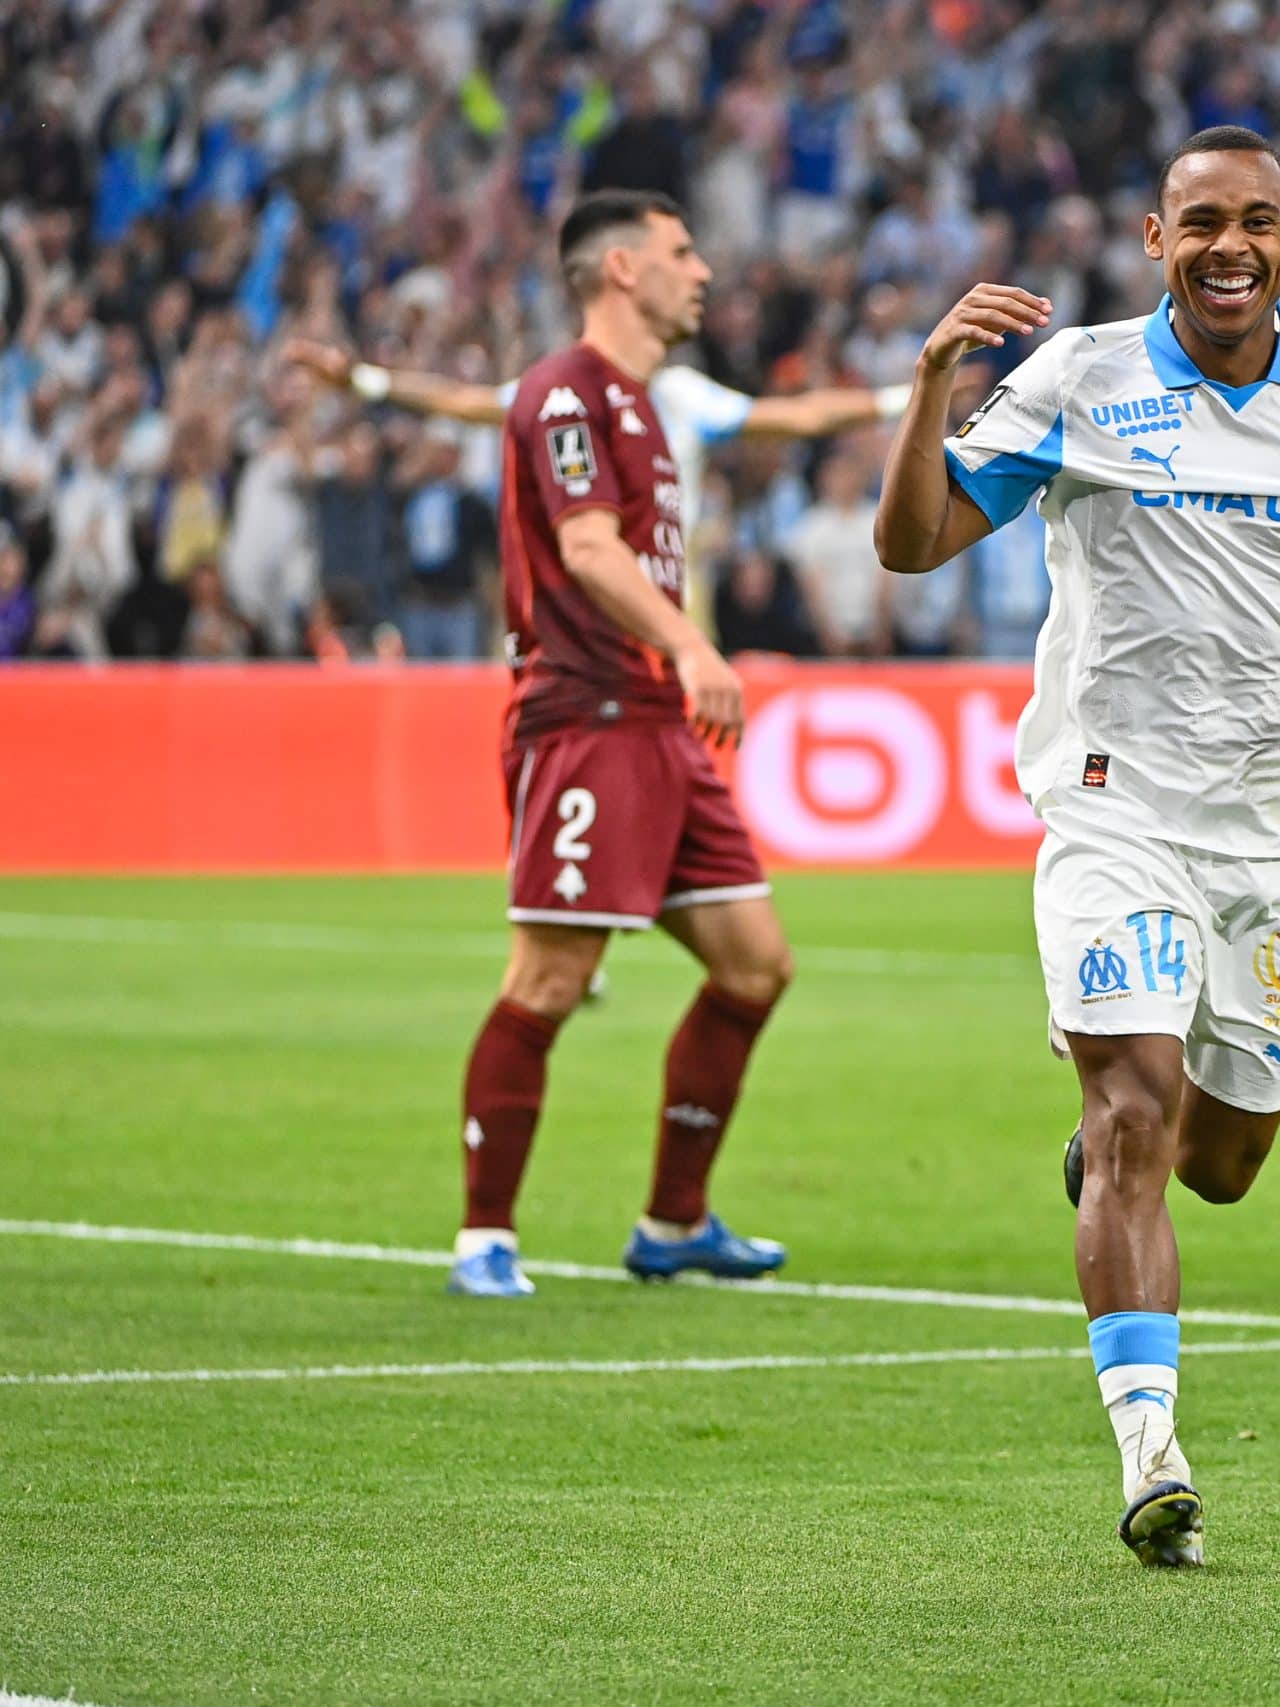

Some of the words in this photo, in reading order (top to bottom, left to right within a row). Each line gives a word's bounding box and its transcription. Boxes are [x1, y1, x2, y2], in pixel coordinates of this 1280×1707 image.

[1091, 389, 1194, 426] UNIBET
[552, 787, 597, 861] 2
[1125, 911, 1187, 997] 14
